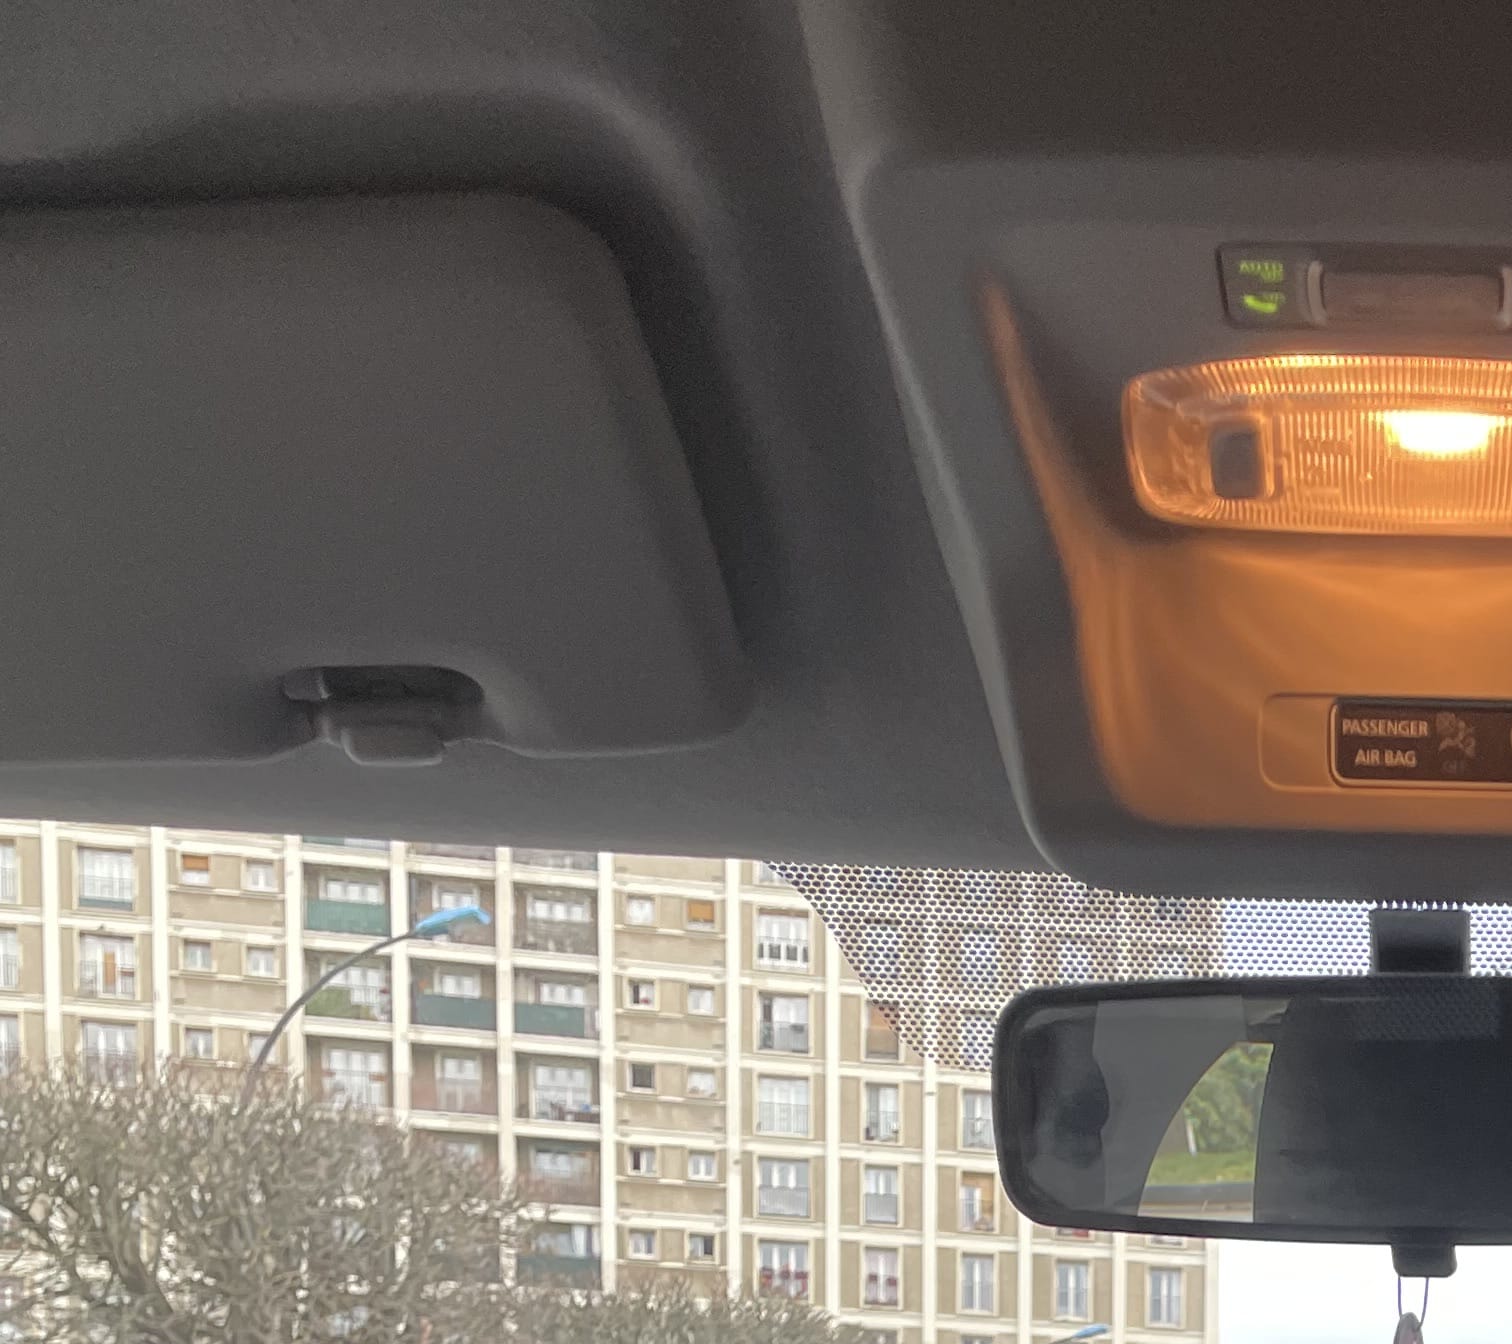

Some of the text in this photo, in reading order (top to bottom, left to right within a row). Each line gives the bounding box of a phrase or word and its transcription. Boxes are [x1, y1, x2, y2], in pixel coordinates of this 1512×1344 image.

[1342, 719, 1428, 738] PASSENGER
[1355, 749, 1416, 768] AIR BAG
